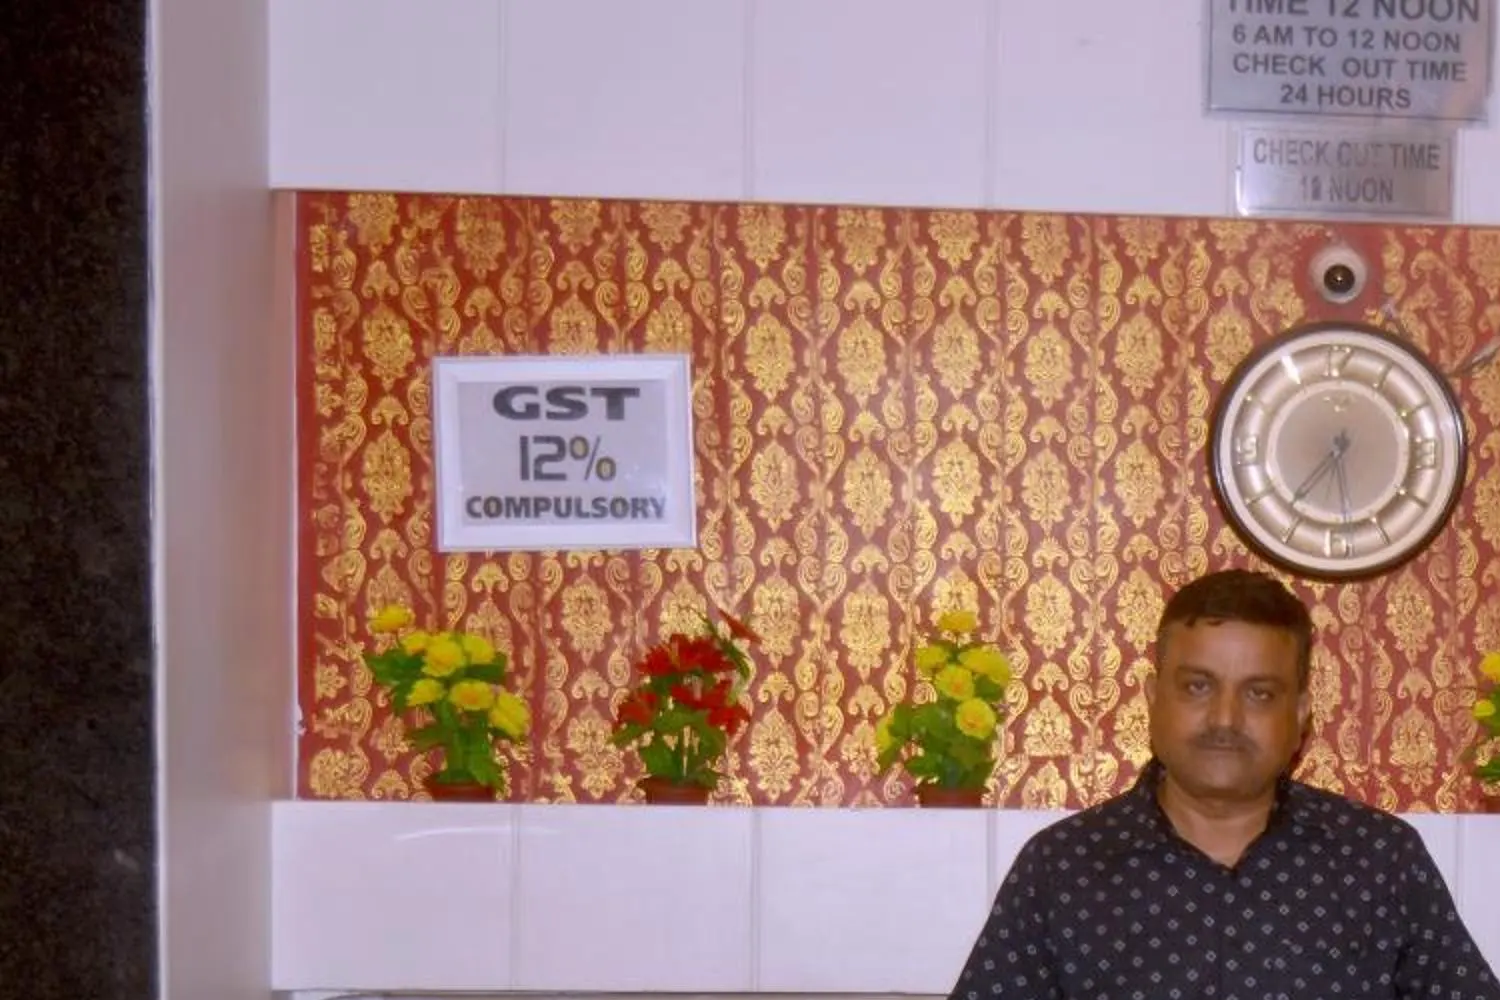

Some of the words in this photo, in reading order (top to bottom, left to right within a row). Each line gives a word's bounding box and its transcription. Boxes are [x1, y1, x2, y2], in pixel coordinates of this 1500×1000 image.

[1327, 0, 1360, 19] 12
[1373, 0, 1481, 24] NOON
[1232, 23, 1247, 45] 6
[1252, 24, 1294, 47] AM
[1302, 25, 1339, 48] TO
[1349, 28, 1375, 50] 12
[1383, 29, 1461, 54] NOON
[1232, 52, 1326, 77] CHECK
[1341, 57, 1398, 80] OUT
[1407, 59, 1468, 83] TIME
[1279, 83, 1309, 105] 24
[1316, 85, 1412, 110] HOURS
[1253, 137, 1331, 167] CHECK
[1388, 141, 1442, 171] TIME
[1328, 176, 1395, 204] NOON
[491, 384, 642, 422] GST
[518, 434, 618, 483] 12%
[464, 494, 668, 521] COMPULSORY
